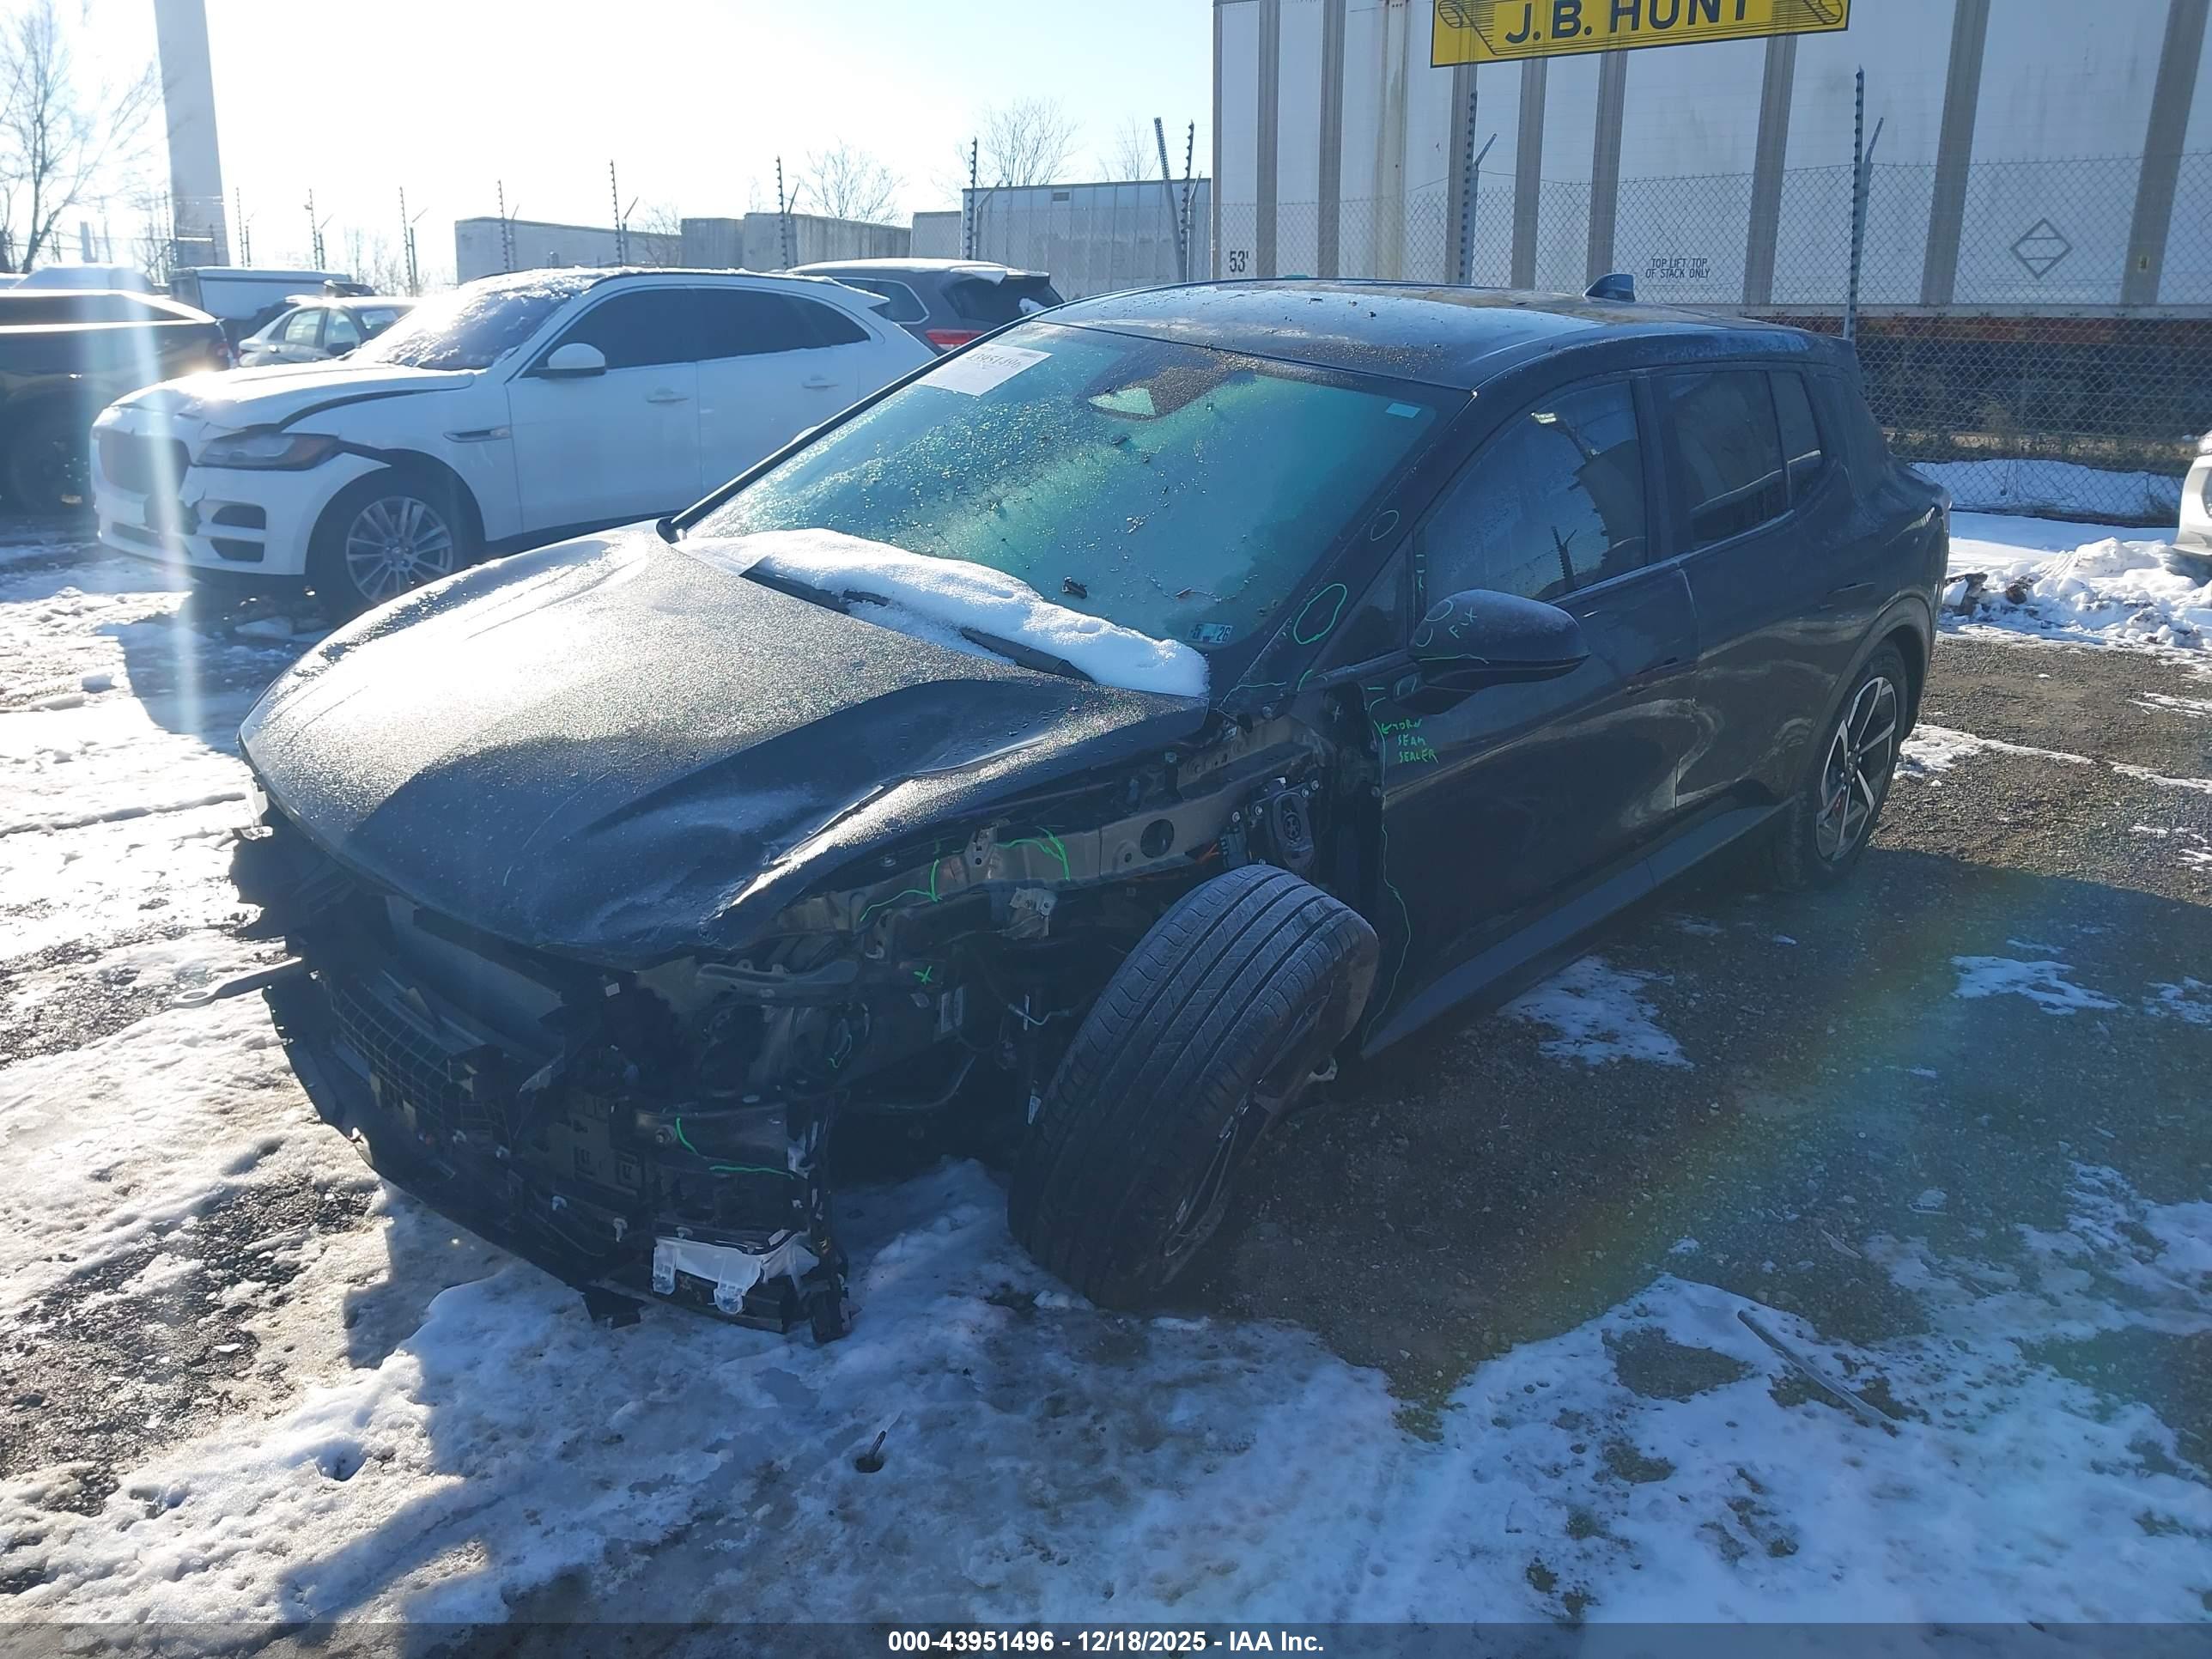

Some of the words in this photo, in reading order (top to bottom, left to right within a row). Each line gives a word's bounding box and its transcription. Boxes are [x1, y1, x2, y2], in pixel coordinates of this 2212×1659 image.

[1504, 0, 1593, 44] J.B.
[1229, 250, 1249, 272] 53'
[1651, 258, 1668, 268] TOP
[1645, 268, 1656, 278] OF
[1660, 268, 1685, 278] STACK
[1689, 268, 1711, 278] ONLY
[1216, 625, 1231, 642] 26
[1398, 733, 1426, 746] SEAM
[1399, 748, 1439, 763] SEALER
